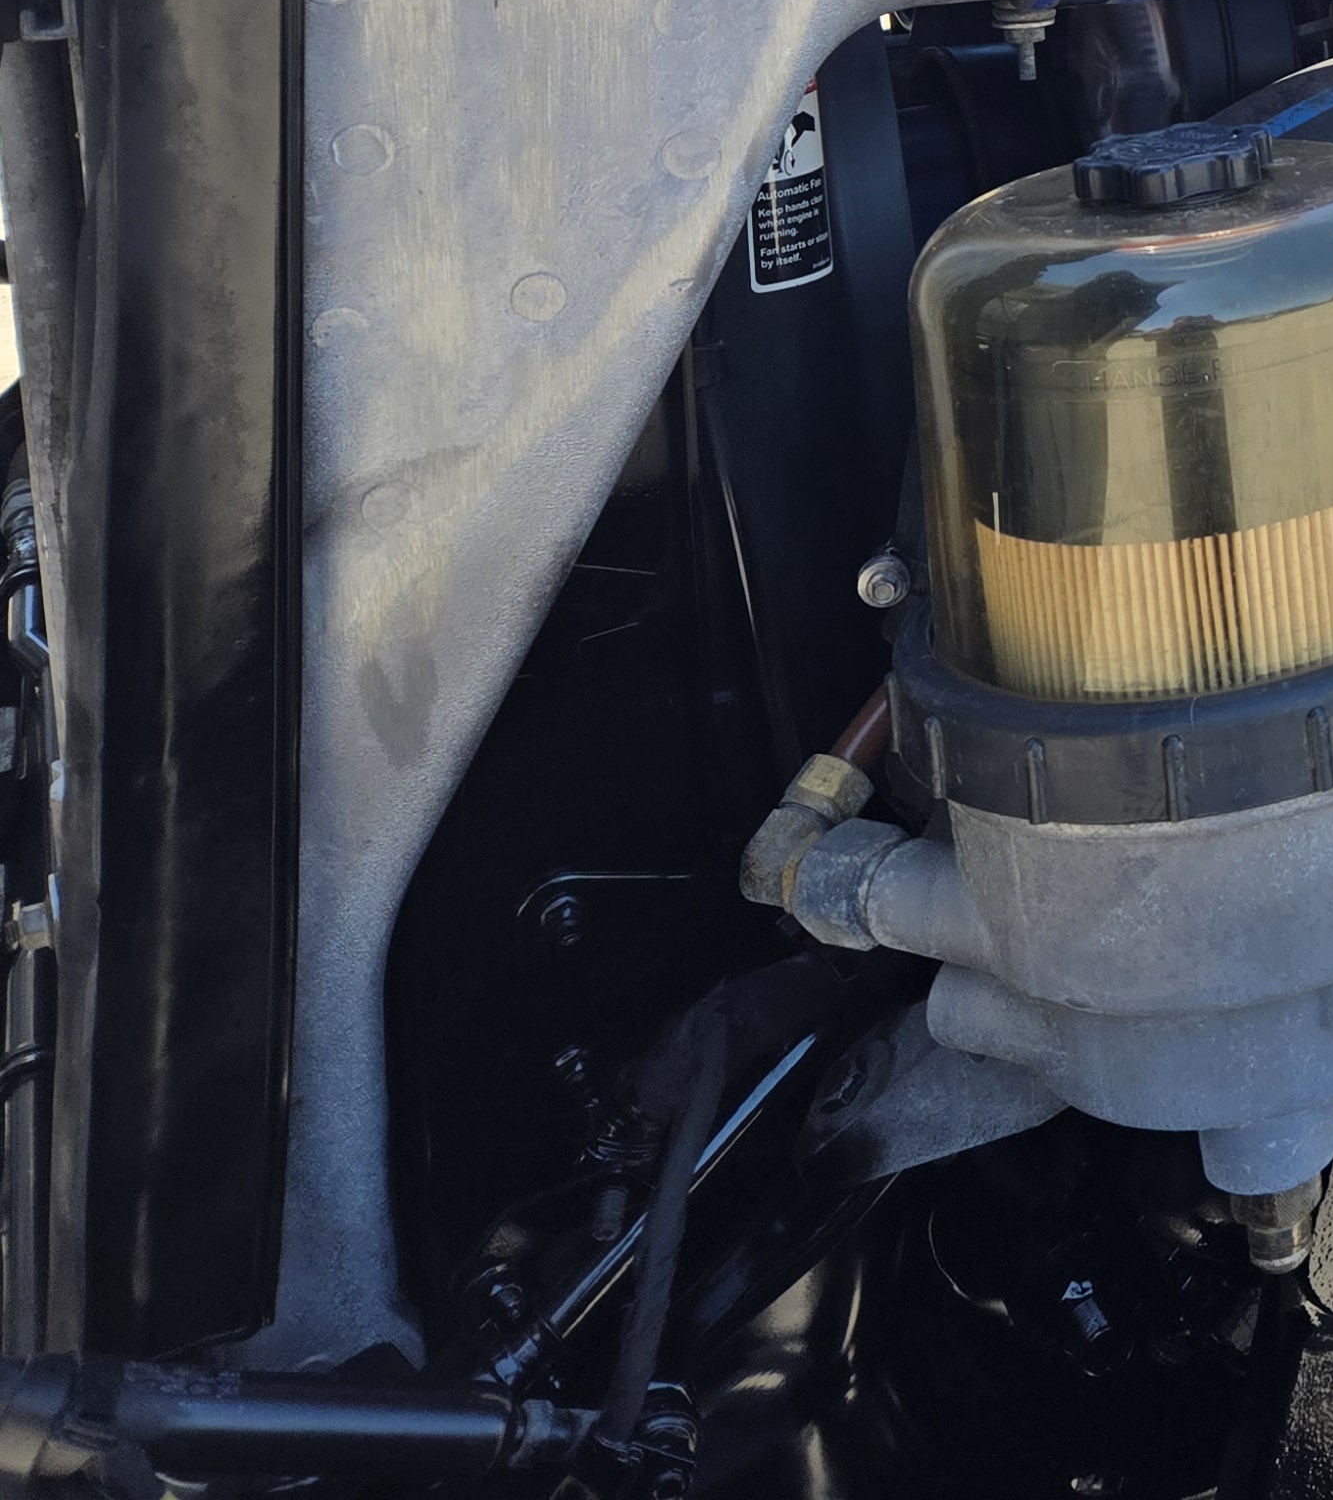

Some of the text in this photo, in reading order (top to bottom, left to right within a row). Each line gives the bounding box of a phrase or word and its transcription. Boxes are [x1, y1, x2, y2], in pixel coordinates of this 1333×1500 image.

[757, 182, 809, 202] Automatic
[758, 207, 784, 218] Keep
[785, 199, 810, 213] hands
[758, 207, 820, 230] when engine is
[759, 227, 799, 241] running.
[760, 247, 779, 258] Fan
[781, 240, 807, 254] starts
[807, 239, 815, 247] or
[761, 260, 774, 270] by
